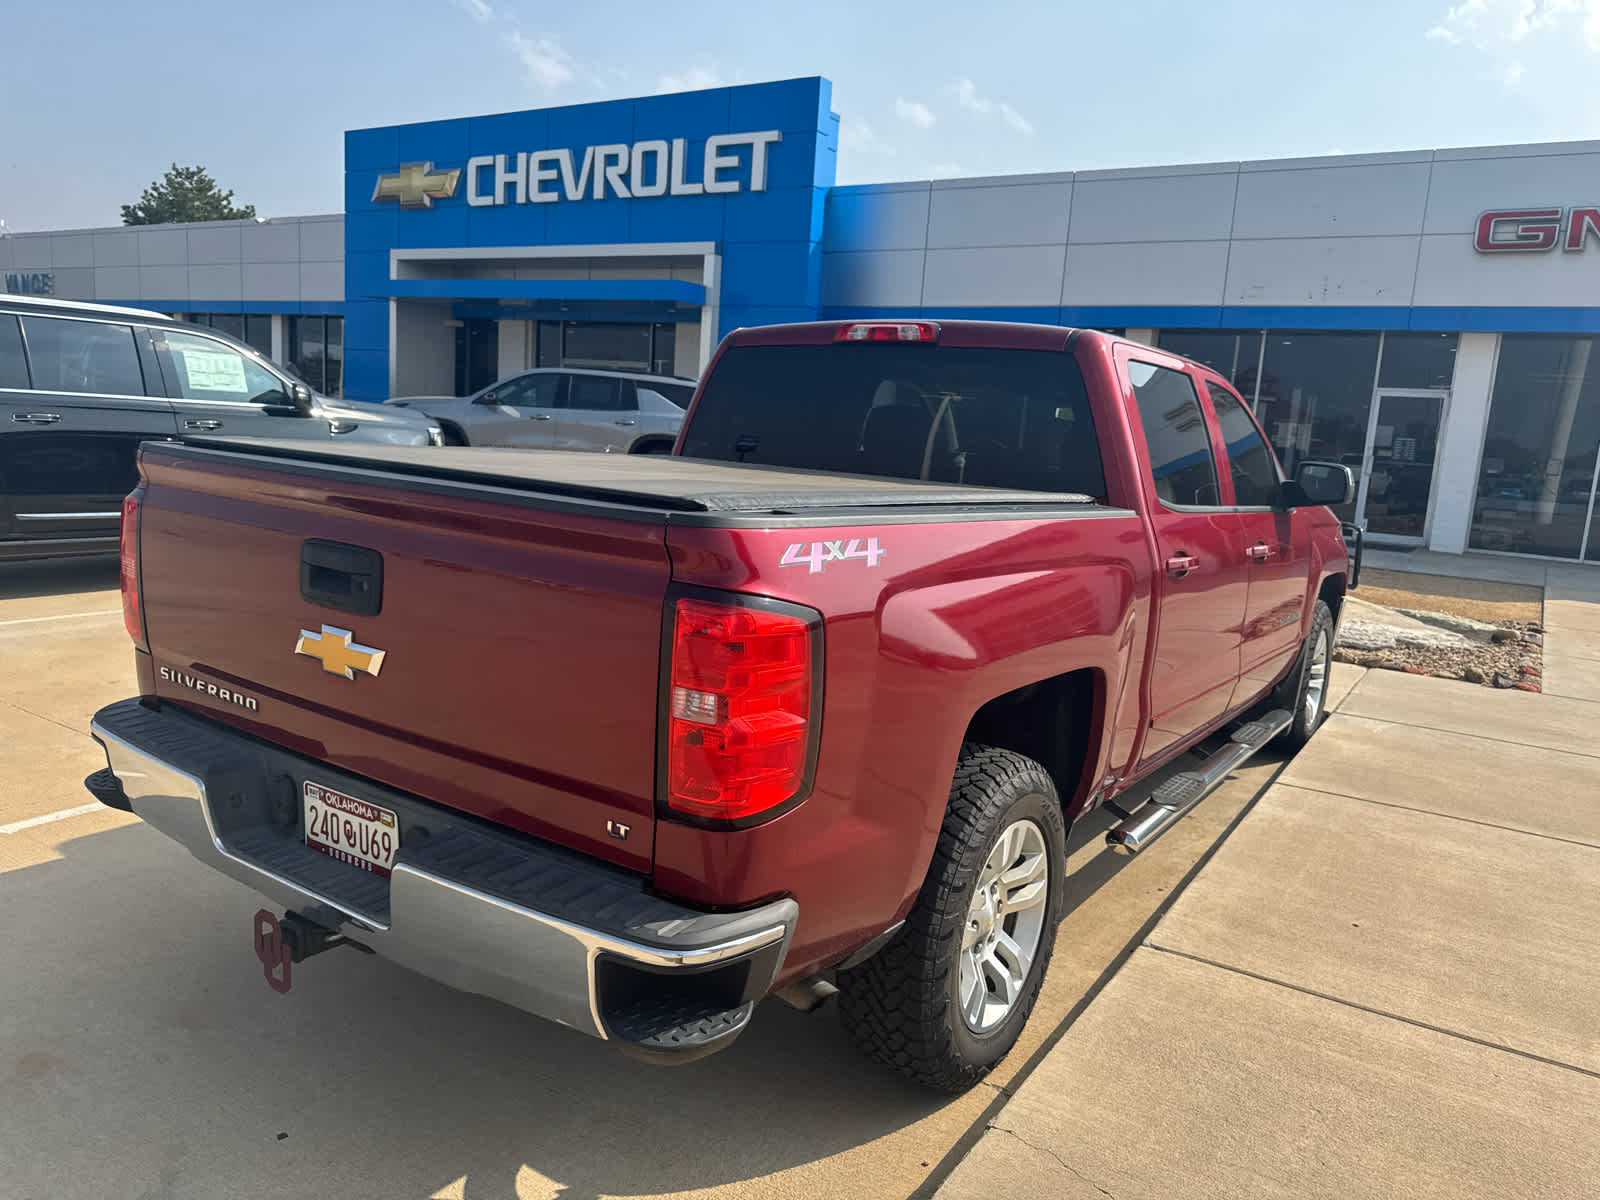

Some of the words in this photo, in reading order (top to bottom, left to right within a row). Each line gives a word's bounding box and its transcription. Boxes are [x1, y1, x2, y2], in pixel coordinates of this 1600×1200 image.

[466, 130, 783, 208] CHEVROLET
[325, 792, 374, 819] OKLAHOMA
[606, 819, 630, 840] LT
